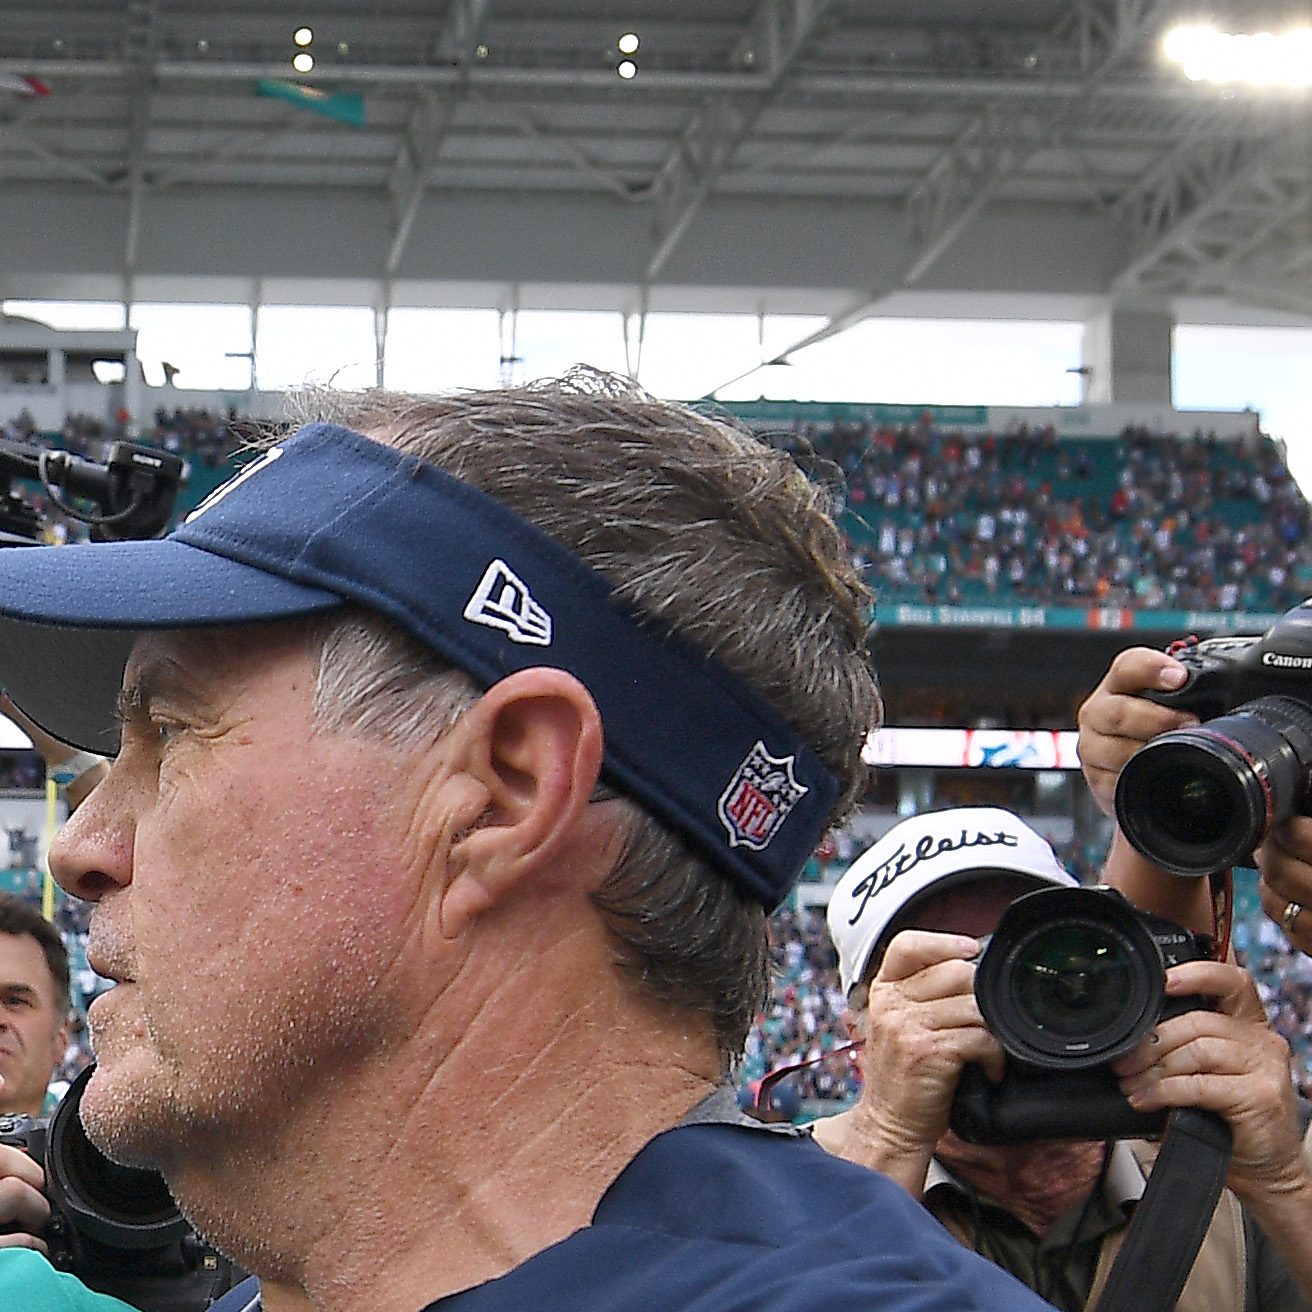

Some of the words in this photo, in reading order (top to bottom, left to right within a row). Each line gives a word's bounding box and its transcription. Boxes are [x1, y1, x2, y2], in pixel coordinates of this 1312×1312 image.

[1262, 652, 1312, 669] Canon
[729, 780, 774, 838] NFL
[848, 828, 1019, 926] Titleist
